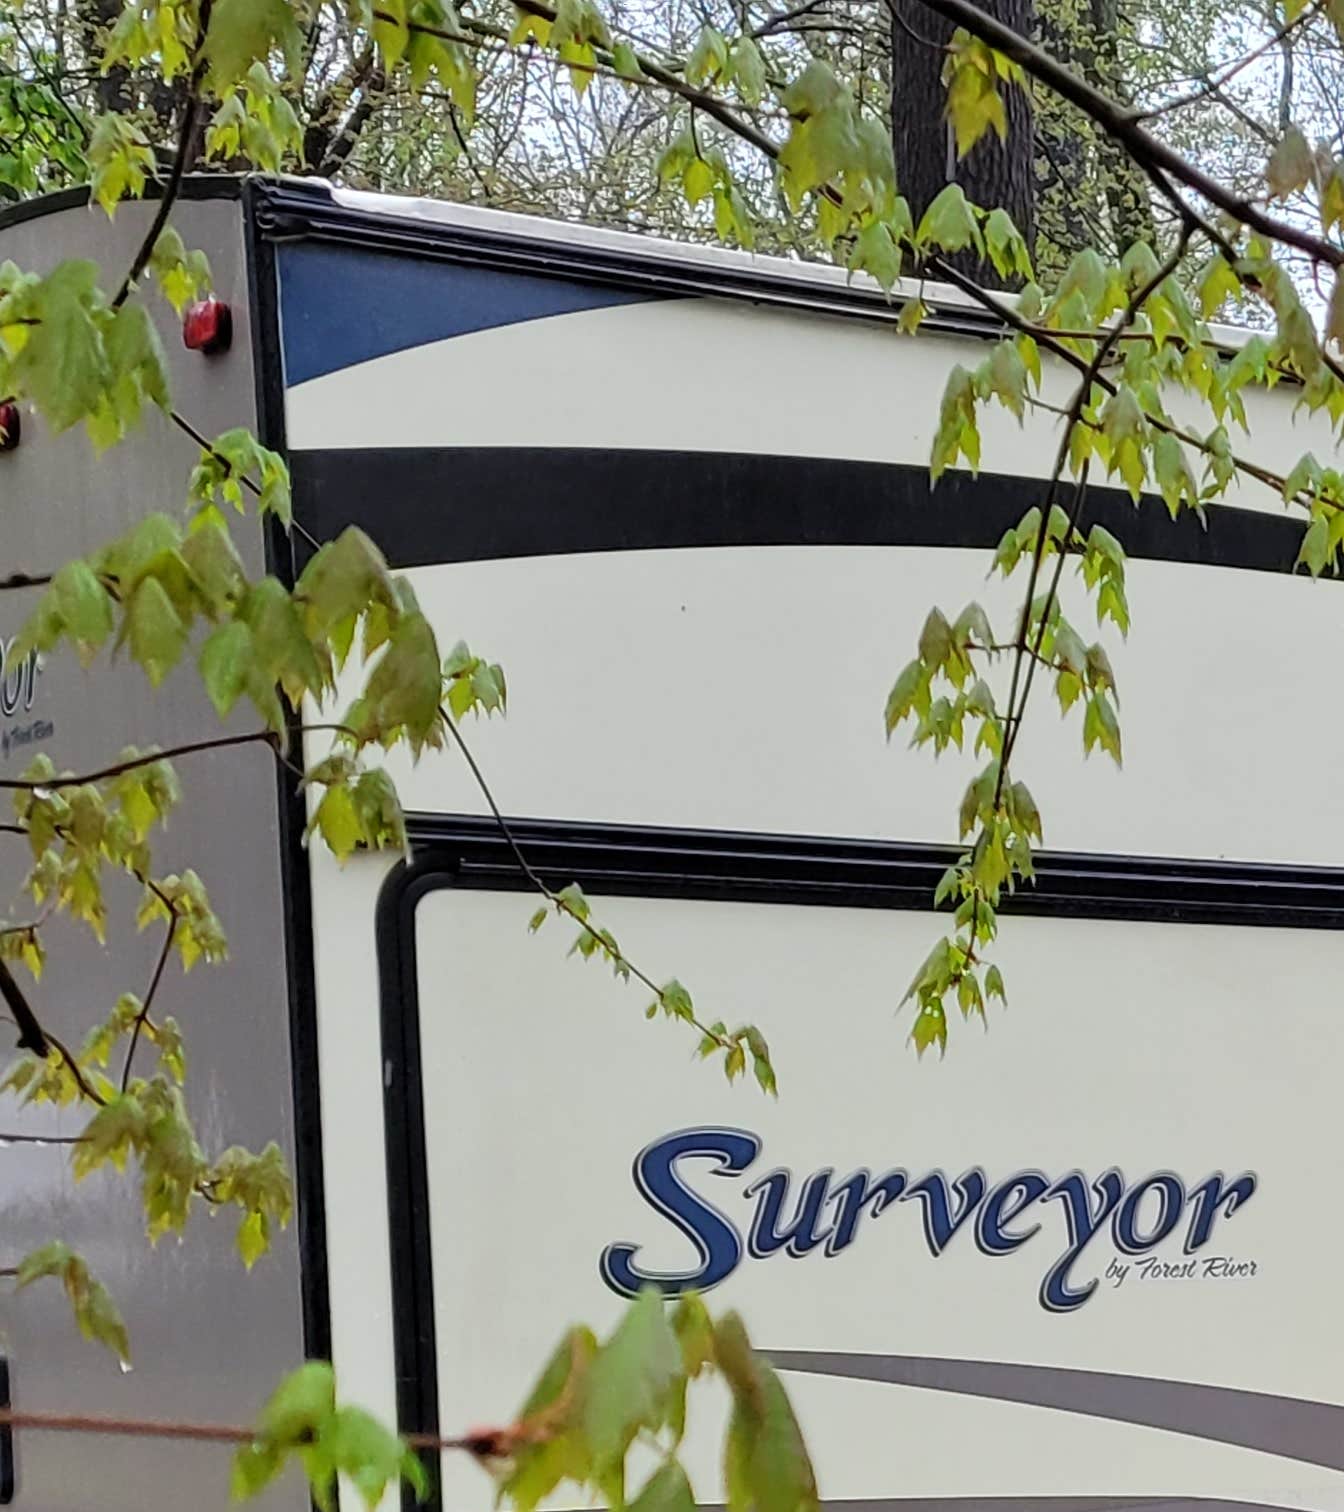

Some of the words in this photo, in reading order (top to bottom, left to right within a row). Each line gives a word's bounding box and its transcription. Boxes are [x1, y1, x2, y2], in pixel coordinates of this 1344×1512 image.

[599, 1125, 1257, 1313] Surveyor
[1105, 1257, 1130, 1288] by
[1134, 1256, 1197, 1280] Forest
[1201, 1256, 1258, 1279] River
